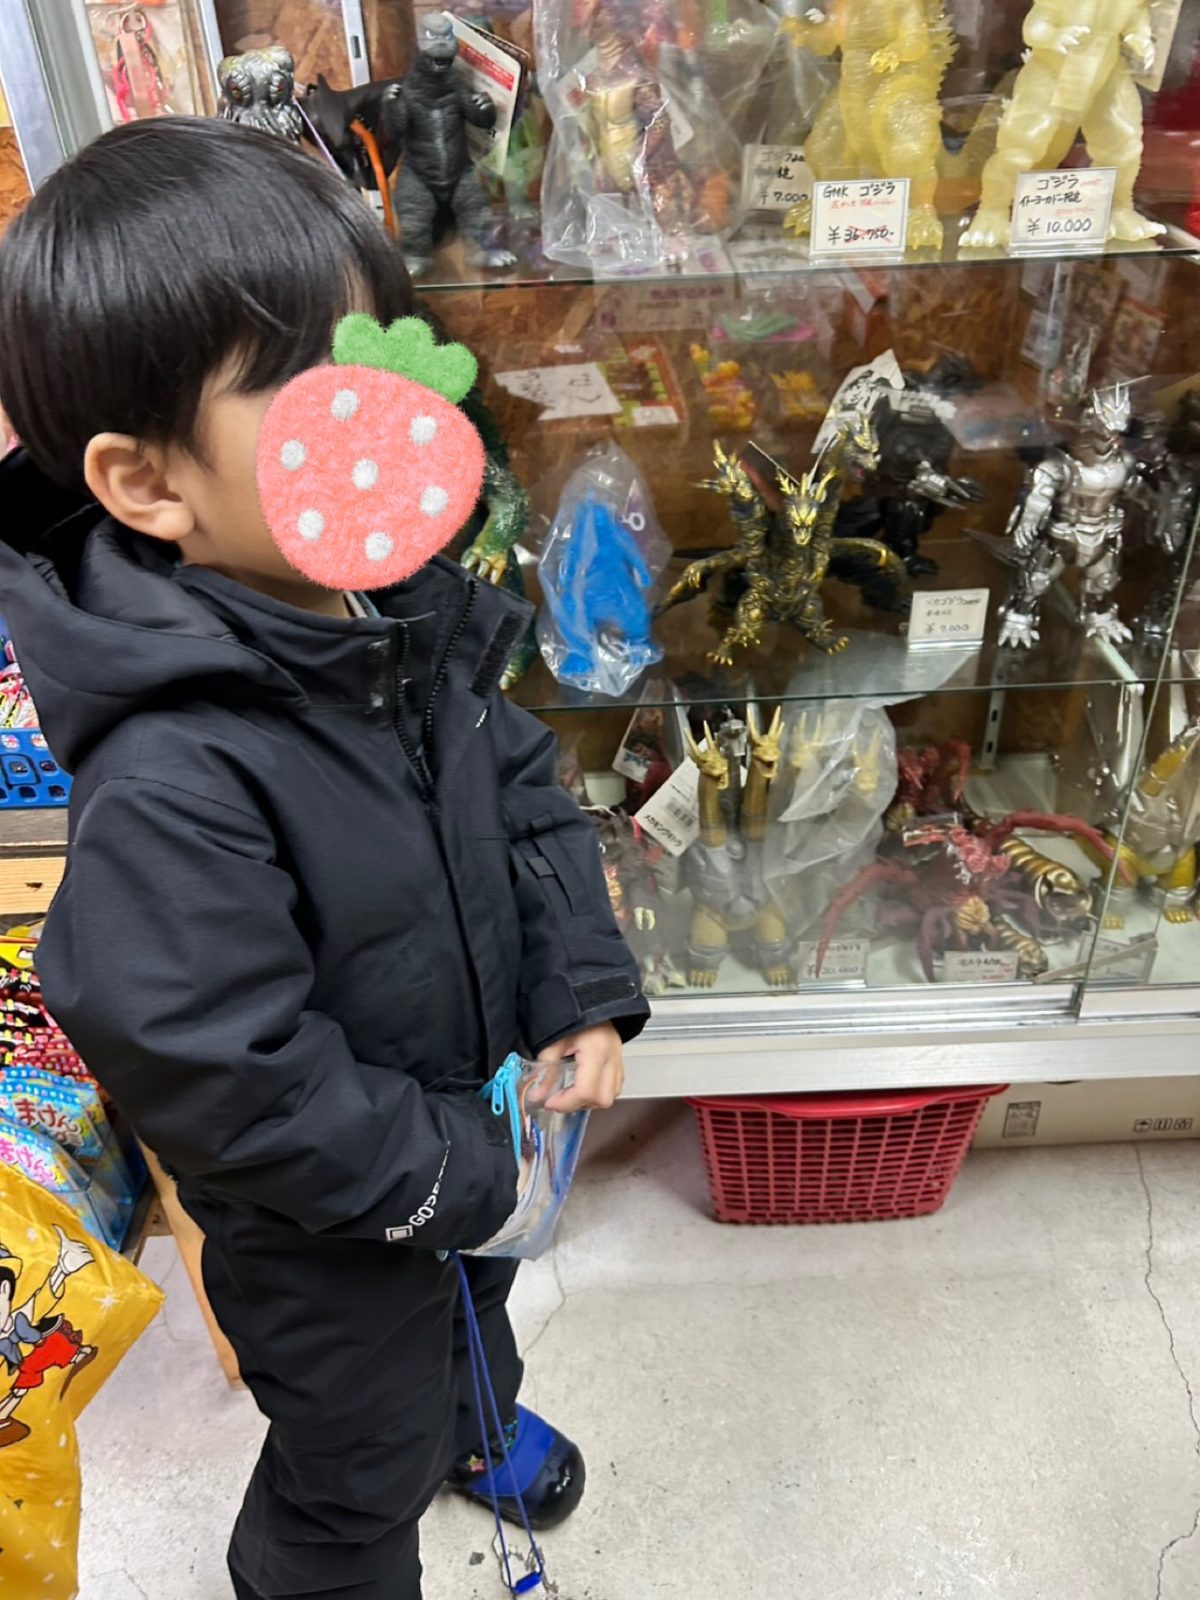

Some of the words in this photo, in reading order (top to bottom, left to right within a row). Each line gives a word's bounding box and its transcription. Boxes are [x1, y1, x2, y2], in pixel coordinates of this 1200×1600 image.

[823, 184, 848, 199] GMK
[859, 181, 896, 197] ゴジラ
[1036, 173, 1080, 191] ゴジラ
